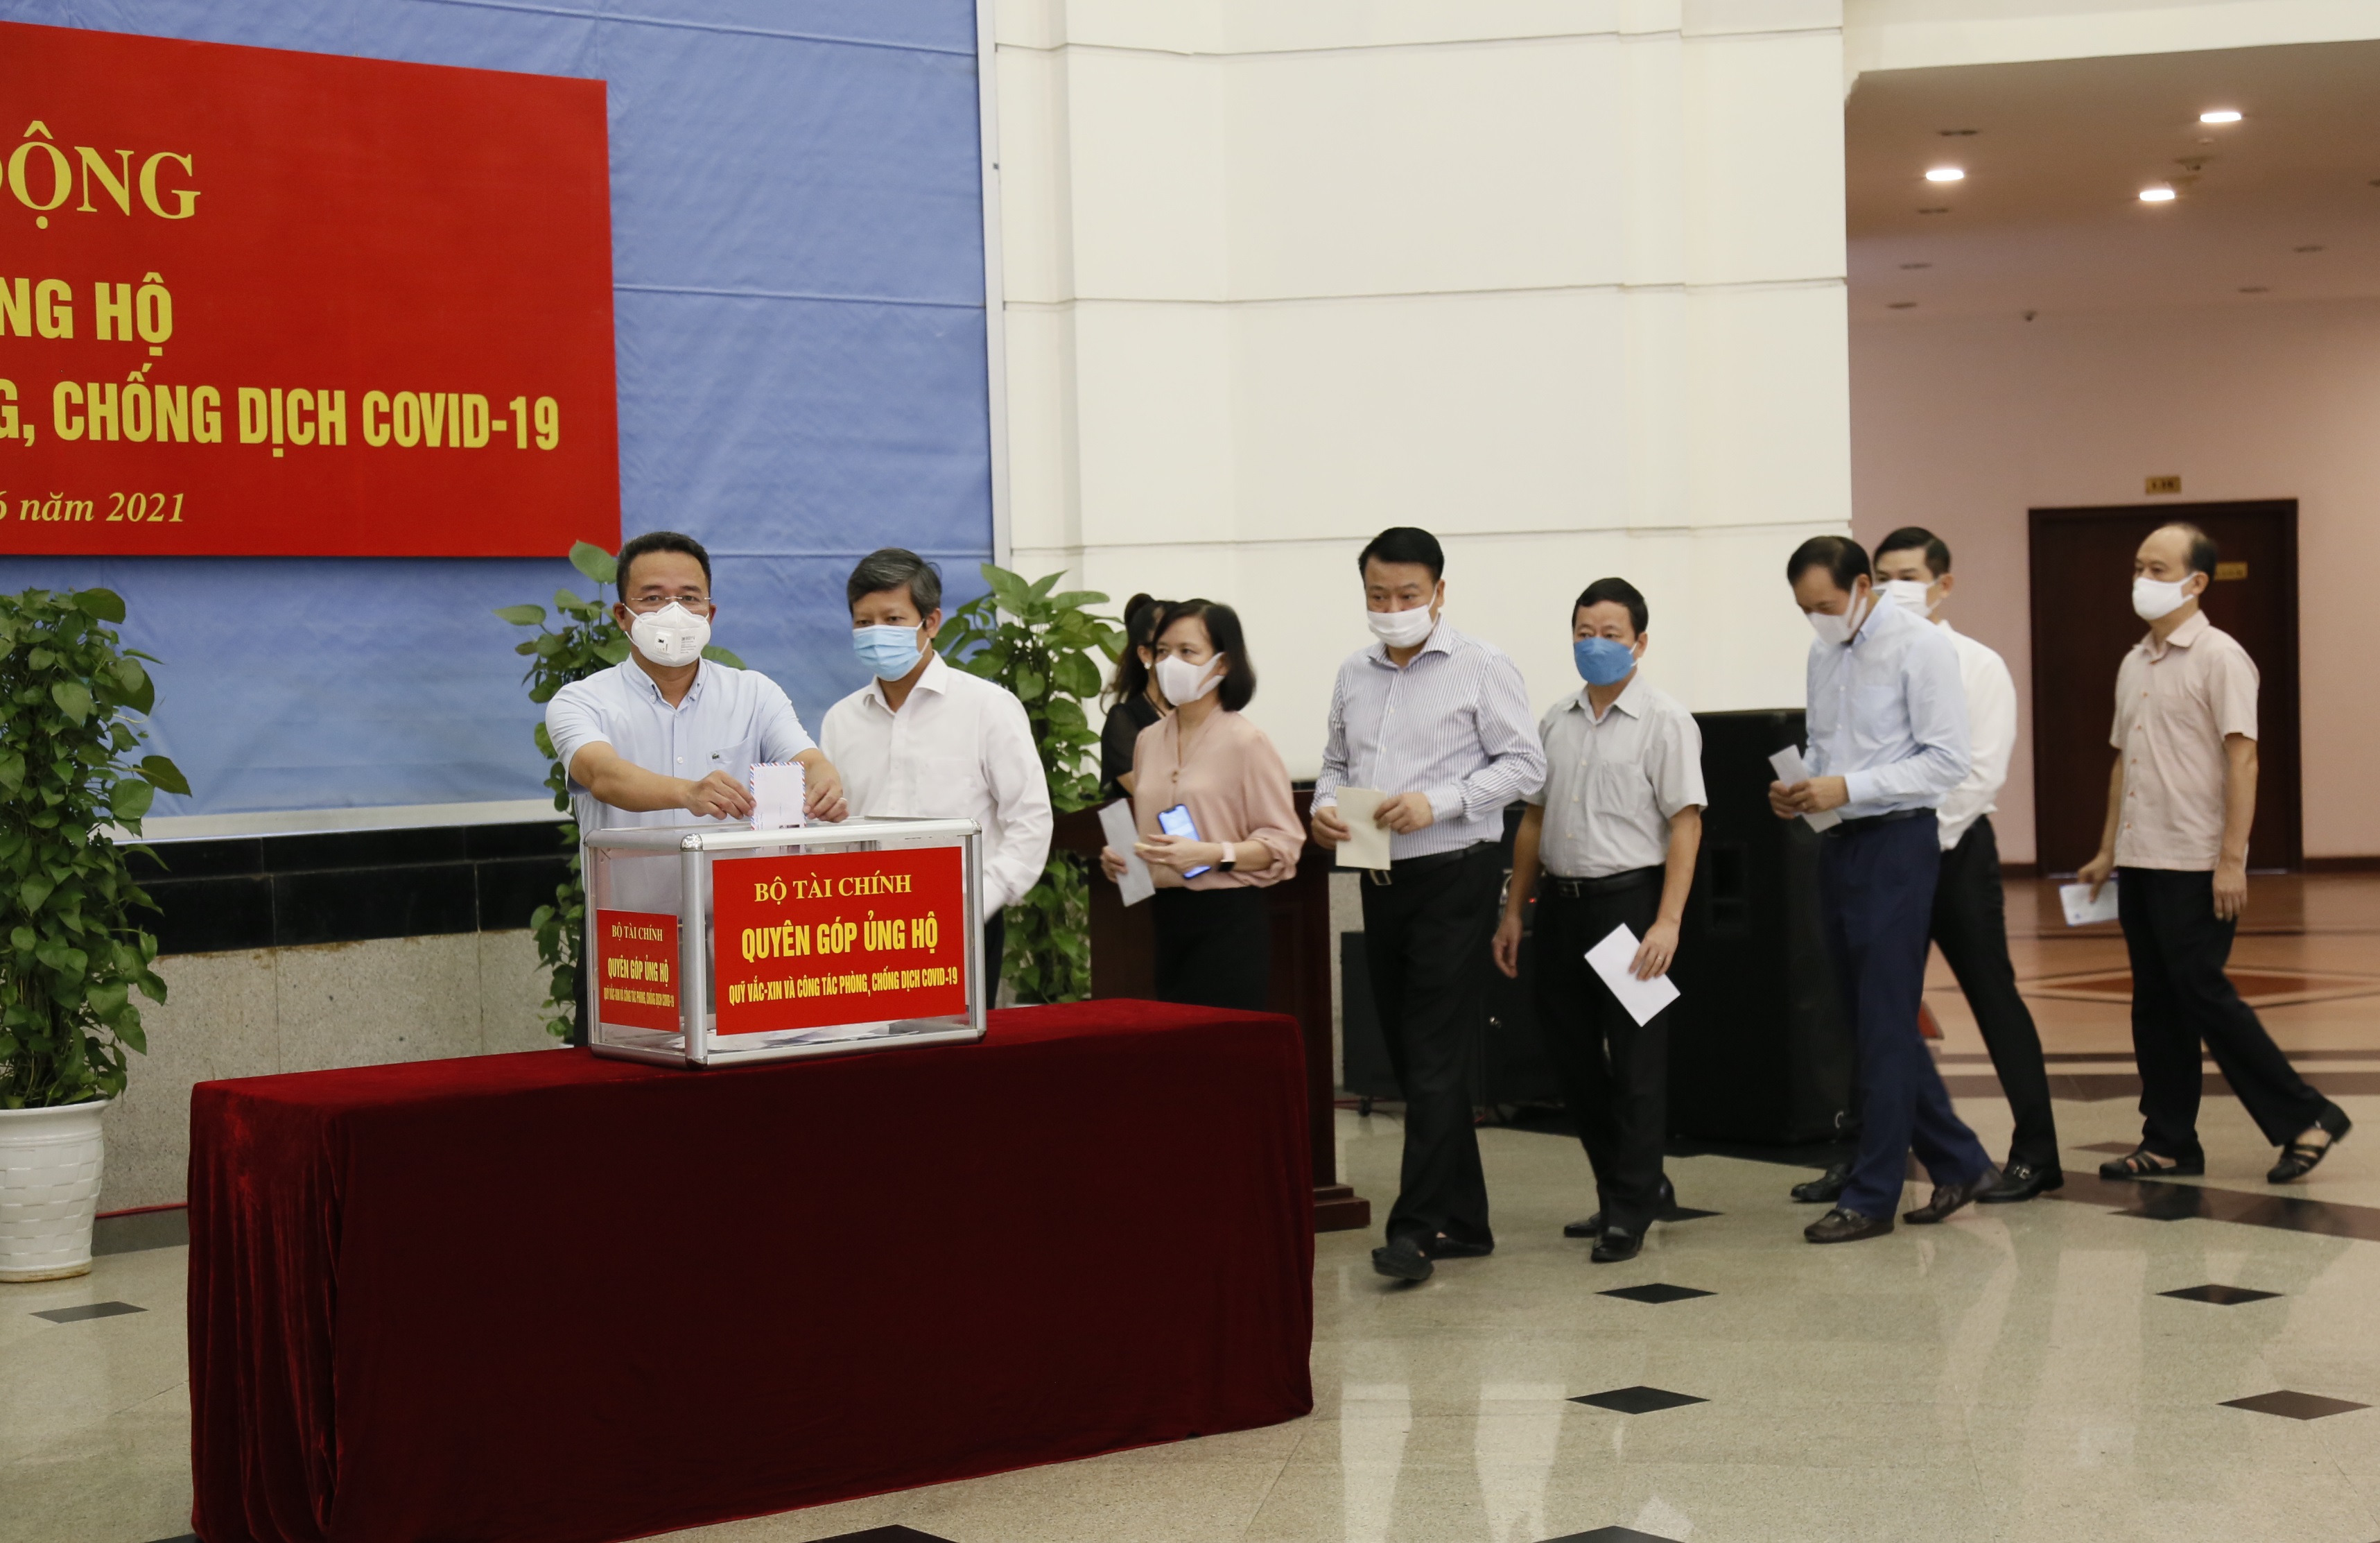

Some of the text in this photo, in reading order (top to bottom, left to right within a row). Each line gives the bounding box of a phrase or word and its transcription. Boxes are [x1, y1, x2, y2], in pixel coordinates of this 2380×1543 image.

[0, 120, 201, 230] ỘNG
[95, 272, 173, 356] HỘ
[53, 363, 222, 444] CHỐNG
[238, 387, 347, 458] DỊCH
[362, 390, 559, 451] COVID-19
[19, 492, 94, 521] năm
[105, 492, 184, 522] 2021
[754, 870, 912, 905] BỘ TÀI CHÍNH
[612, 922, 663, 942] BỘ TÀI CHÍNH
[742, 910, 938, 963] QUYÊN GÓP ỦNG HỘ
[608, 954, 669, 988] QUYÊN GÓP ỦNG HỘ
[729, 965, 958, 1006] QUỸ VẮC-XIN VÀ CÔNG TÁC PHÒNG, CHỐNG DỊCH COVID-19
